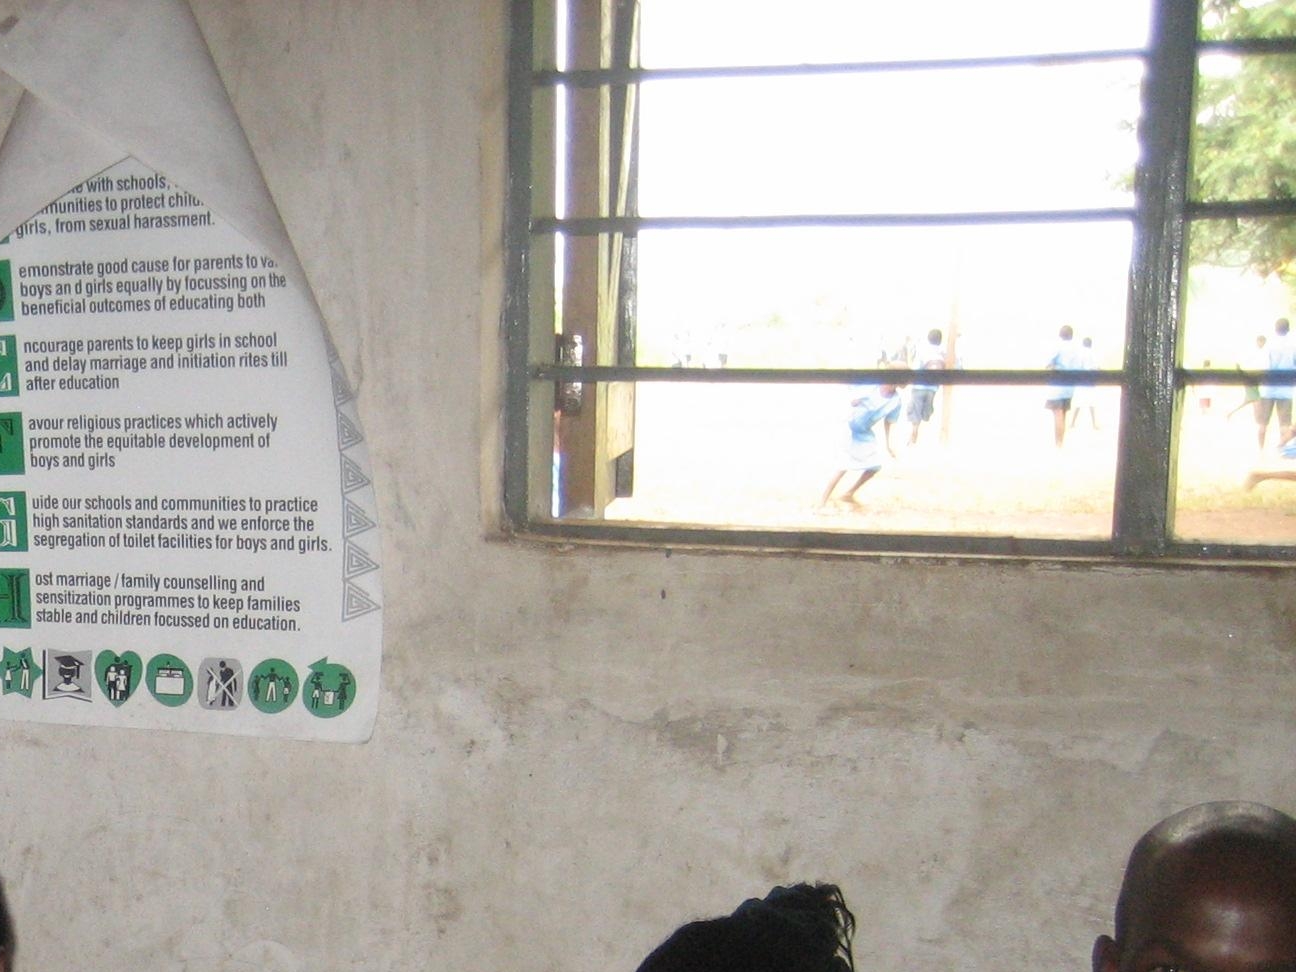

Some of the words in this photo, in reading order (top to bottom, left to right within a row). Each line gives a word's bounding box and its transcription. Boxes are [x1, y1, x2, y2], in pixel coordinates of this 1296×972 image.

[14, 220, 53, 239] girls,
[55, 217, 87, 233] from
[88, 213, 131, 232] sexual
[133, 210, 215, 229] harassment.
[18, 260, 95, 279] emonstrate
[97, 257, 129, 279] good
[131, 259, 170, 274] cause
[172, 255, 191, 272] for
[193, 254, 244, 275] parents
[245, 253, 259, 269] to
[19, 281, 53, 300] boys
[85, 277, 113, 298] girls
[115, 276, 164, 297] equally
[165, 275, 182, 295] by
[184, 273, 248, 293] focussing
[250, 275, 267, 289] on
[268, 271, 287, 289] the
[21, 297, 87, 317] beneficial
[89, 297, 151, 314] outcomes
[153, 295, 167, 312] of
[169, 293, 234, 313] educating
[237, 291, 266, 309] both
[23, 339, 84, 356] ncourage
[86, 335, 135, 356] parents
[135, 335, 149, 351] to
[151, 335, 183, 353] keep
[185, 333, 216, 353] girls
[219, 332, 232, 349] in
[234, 331, 277, 349] school
[24, 355, 50, 373] and
[52, 355, 87, 375] delay
[89, 354, 147, 373] marriage
[149, 353, 175, 370] and
[177, 351, 236, 369] initiation
[239, 351, 269, 368] rites
[270, 351, 288, 367] till
[25, 375, 57, 391] after
[58, 373, 120, 391] education
[28, 417, 65, 431] avour
[66, 414, 121, 434] religious
[123, 413, 183, 433] practices
[184, 413, 224, 429] which
[226, 412, 278, 433] actively
[29, 433, 82, 453] promote
[83, 432, 104, 449] the
[106, 432, 166, 453] equitable
[168, 432, 255, 452] development
[257, 432, 271, 449] of
[29, 452, 60, 471] boys
[62, 451, 85, 468] and
[87, 451, 116, 471] girls
[31, 494, 59, 510] uide
[61, 497, 83, 510] our
[84, 495, 132, 511] schools
[134, 495, 159, 511] and
[161, 495, 247, 512] communities
[248, 496, 262, 512] to
[265, 496, 319, 515] practice
[32, 512, 60, 532] high
[62, 513, 123, 529] sanitation
[125, 513, 189, 531] standards
[190, 514, 215, 531] and
[217, 517, 238, 531] we
[240, 515, 291, 532] enforce
[292, 515, 315, 532] the
[33, 531, 106, 551] segregation
[108, 532, 121, 548] of
[122, 532, 155, 549] toilet
[157, 533, 213, 550] facilities
[215, 533, 234, 550] for
[235, 534, 268, 554] boys
[269, 535, 295, 551] and
[297, 535, 333, 555] girls.
[35, 571, 54, 587] ost
[55, 571, 112, 591] marriage
[120, 572, 161, 593] family
[163, 574, 238, 595] counselling
[240, 575, 265, 592] and
[35, 589, 112, 607] sensitization
[113, 594, 195, 611] programmes
[197, 593, 210, 610] to
[212, 593, 245, 614] keep
[246, 594, 301, 613] families
[35, 607, 73, 624] stable
[75, 609, 99, 625] and
[100, 609, 152, 627] children
[153, 611, 211, 629] focussed
[213, 616, 229, 629] on
[232, 613, 301, 632] education.
